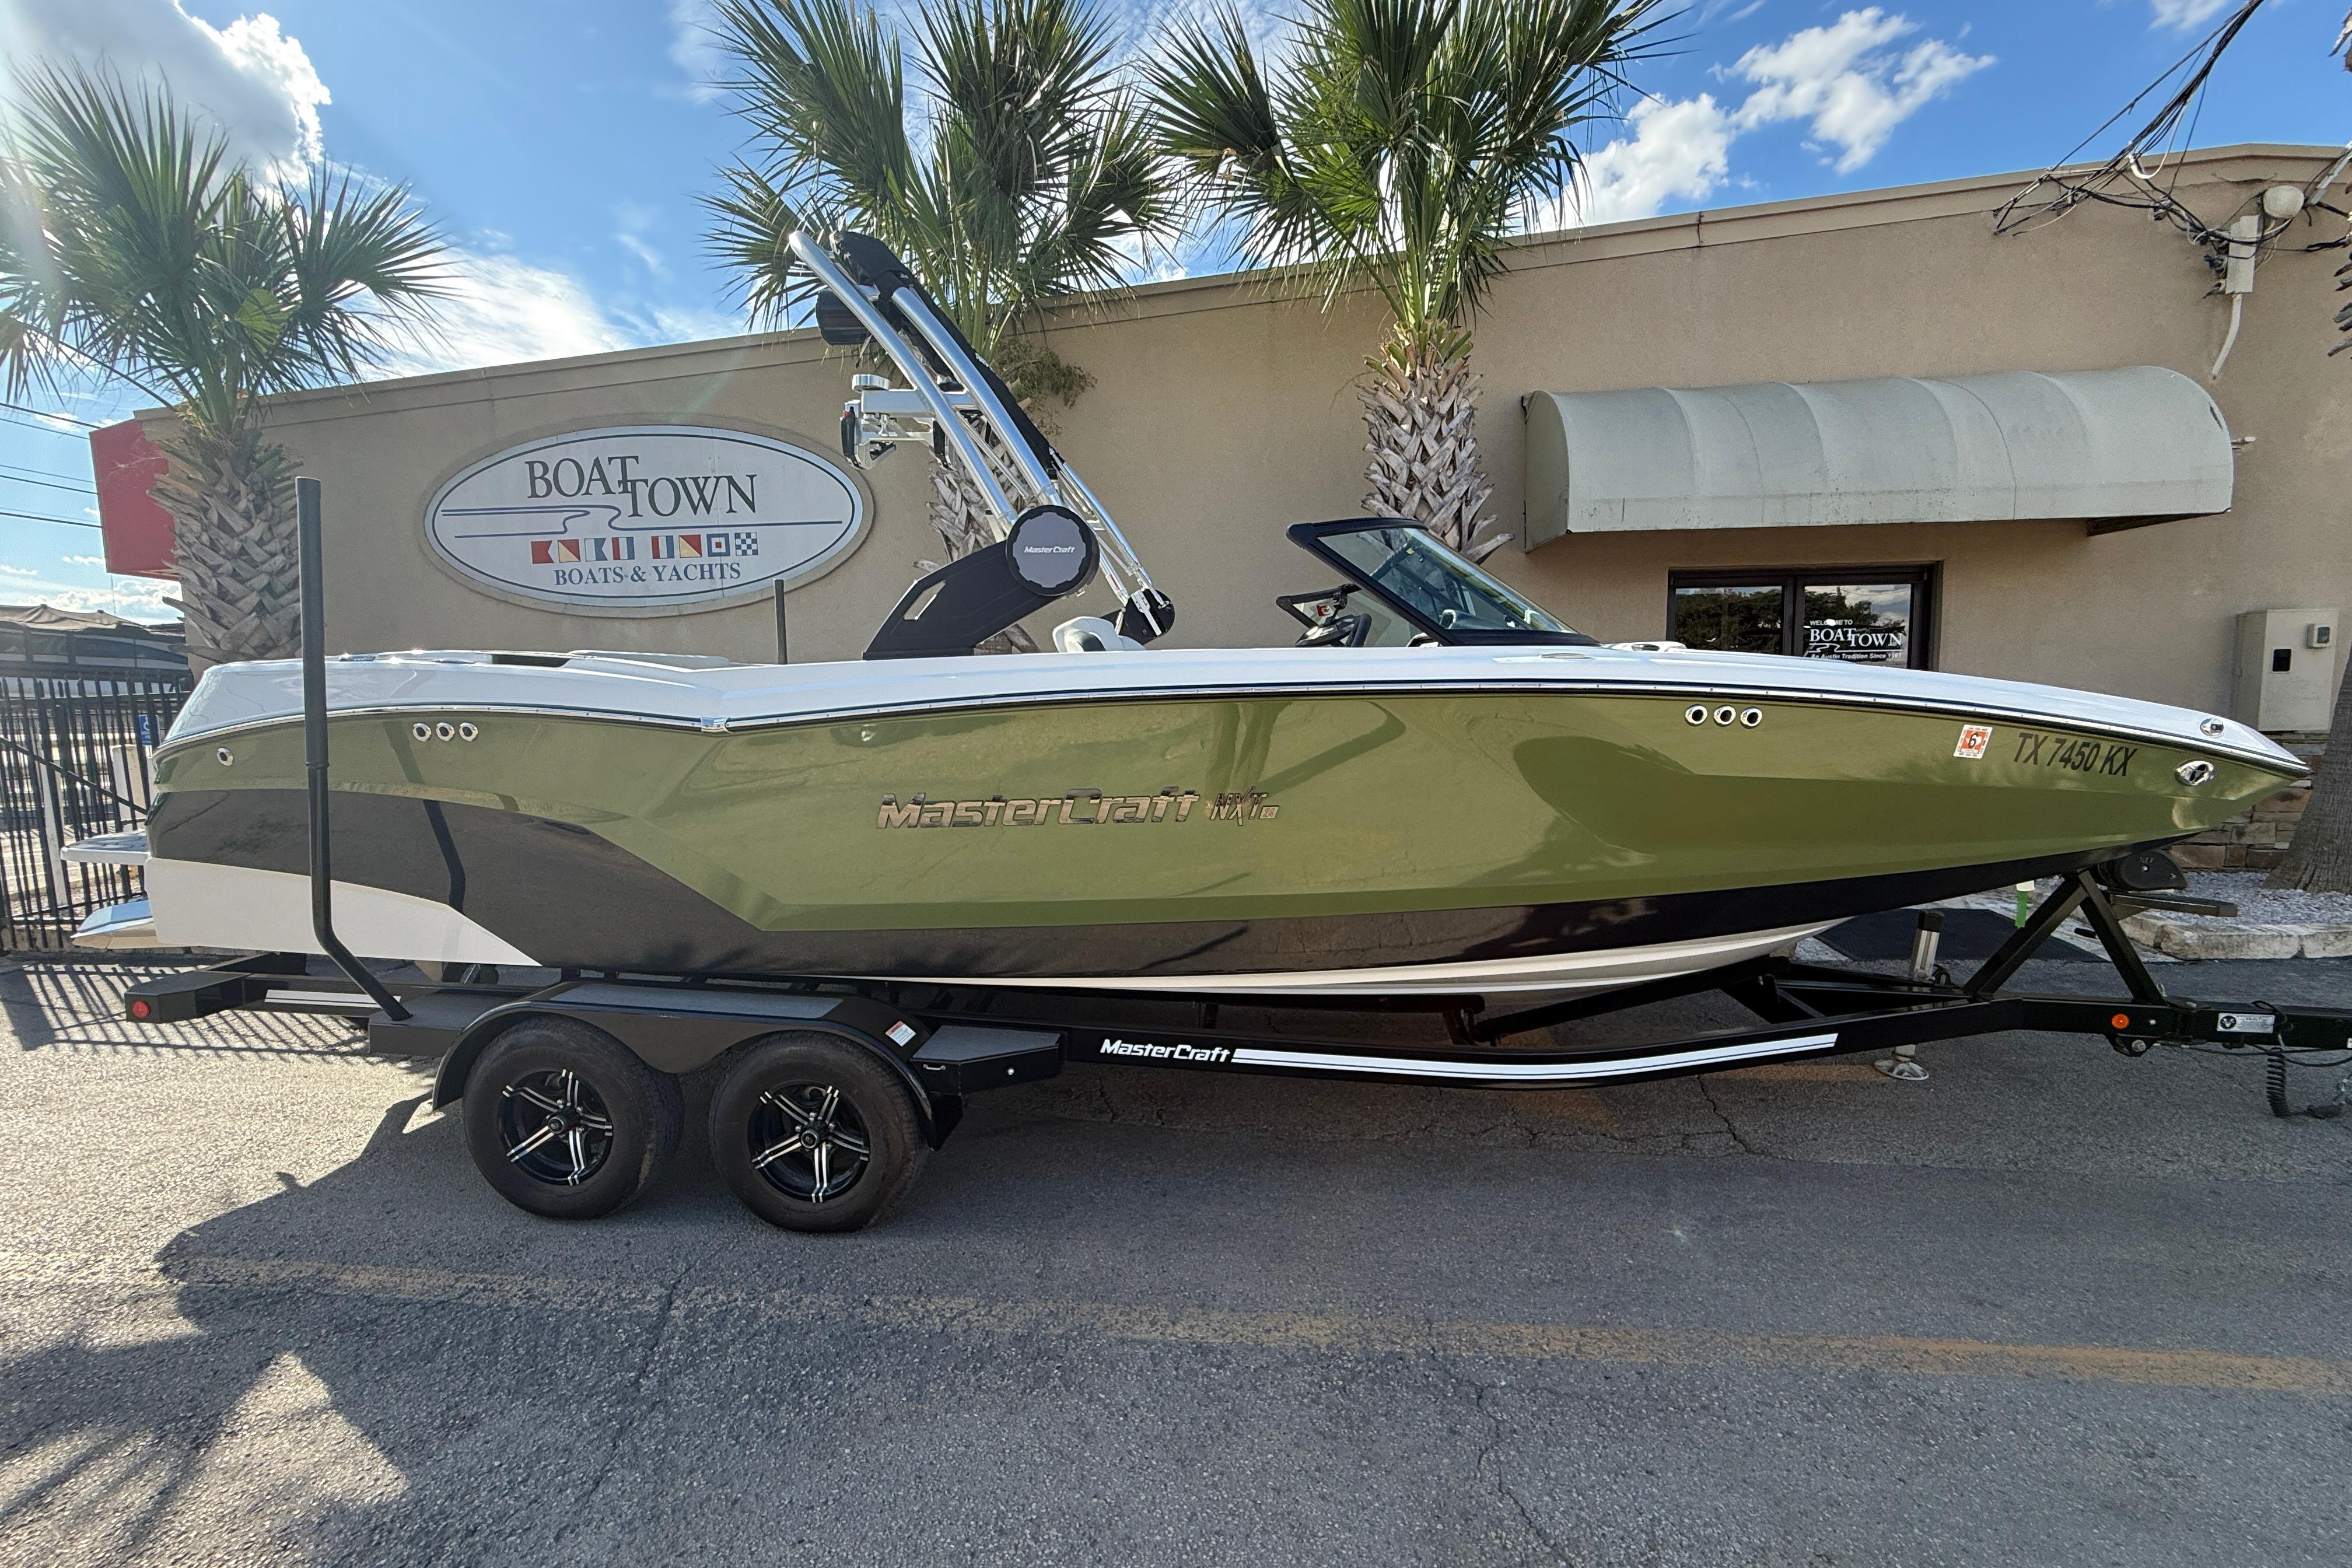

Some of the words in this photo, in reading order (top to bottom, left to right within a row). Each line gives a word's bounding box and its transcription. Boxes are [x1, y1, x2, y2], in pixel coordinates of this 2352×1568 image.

[554, 567, 624, 586] BOATS
[630, 565, 647, 582] &
[652, 562, 741, 582] YACHTS
[1968, 732, 1979, 749] 6
[2014, 733, 2049, 765] TX
[2046, 738, 2101, 772] 7450
[2099, 745, 2138, 776] KX
[876, 786, 1200, 828] MasterCraft
[1100, 1038, 1231, 1062] MasterCraft
